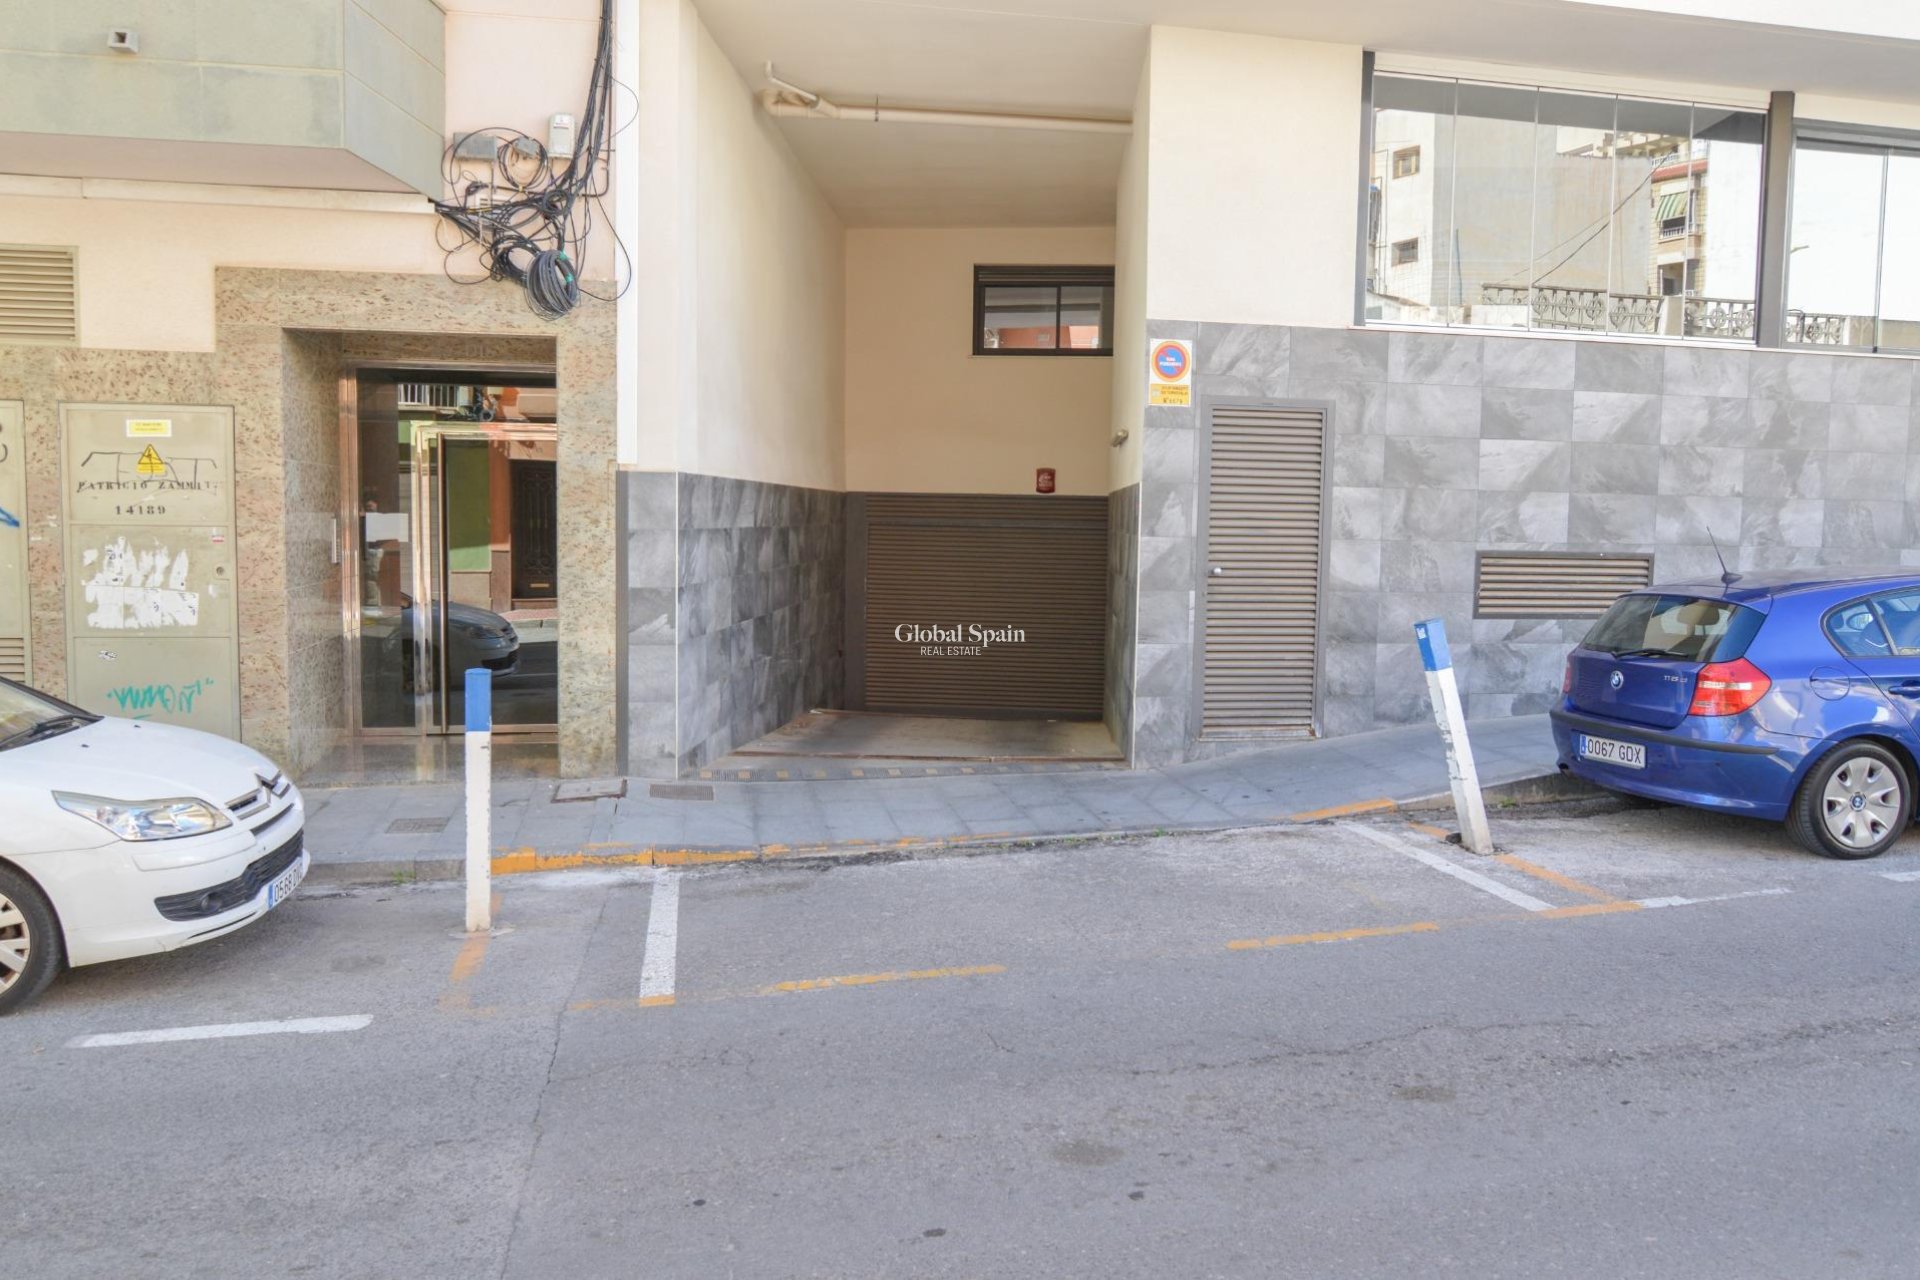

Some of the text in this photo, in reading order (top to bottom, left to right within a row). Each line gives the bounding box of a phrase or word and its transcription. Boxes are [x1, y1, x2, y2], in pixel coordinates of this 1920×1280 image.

[79, 480, 148, 490] PATRICIO
[115, 505, 166, 515] 14189
[1587, 738, 1642, 764] 0067 GDX
